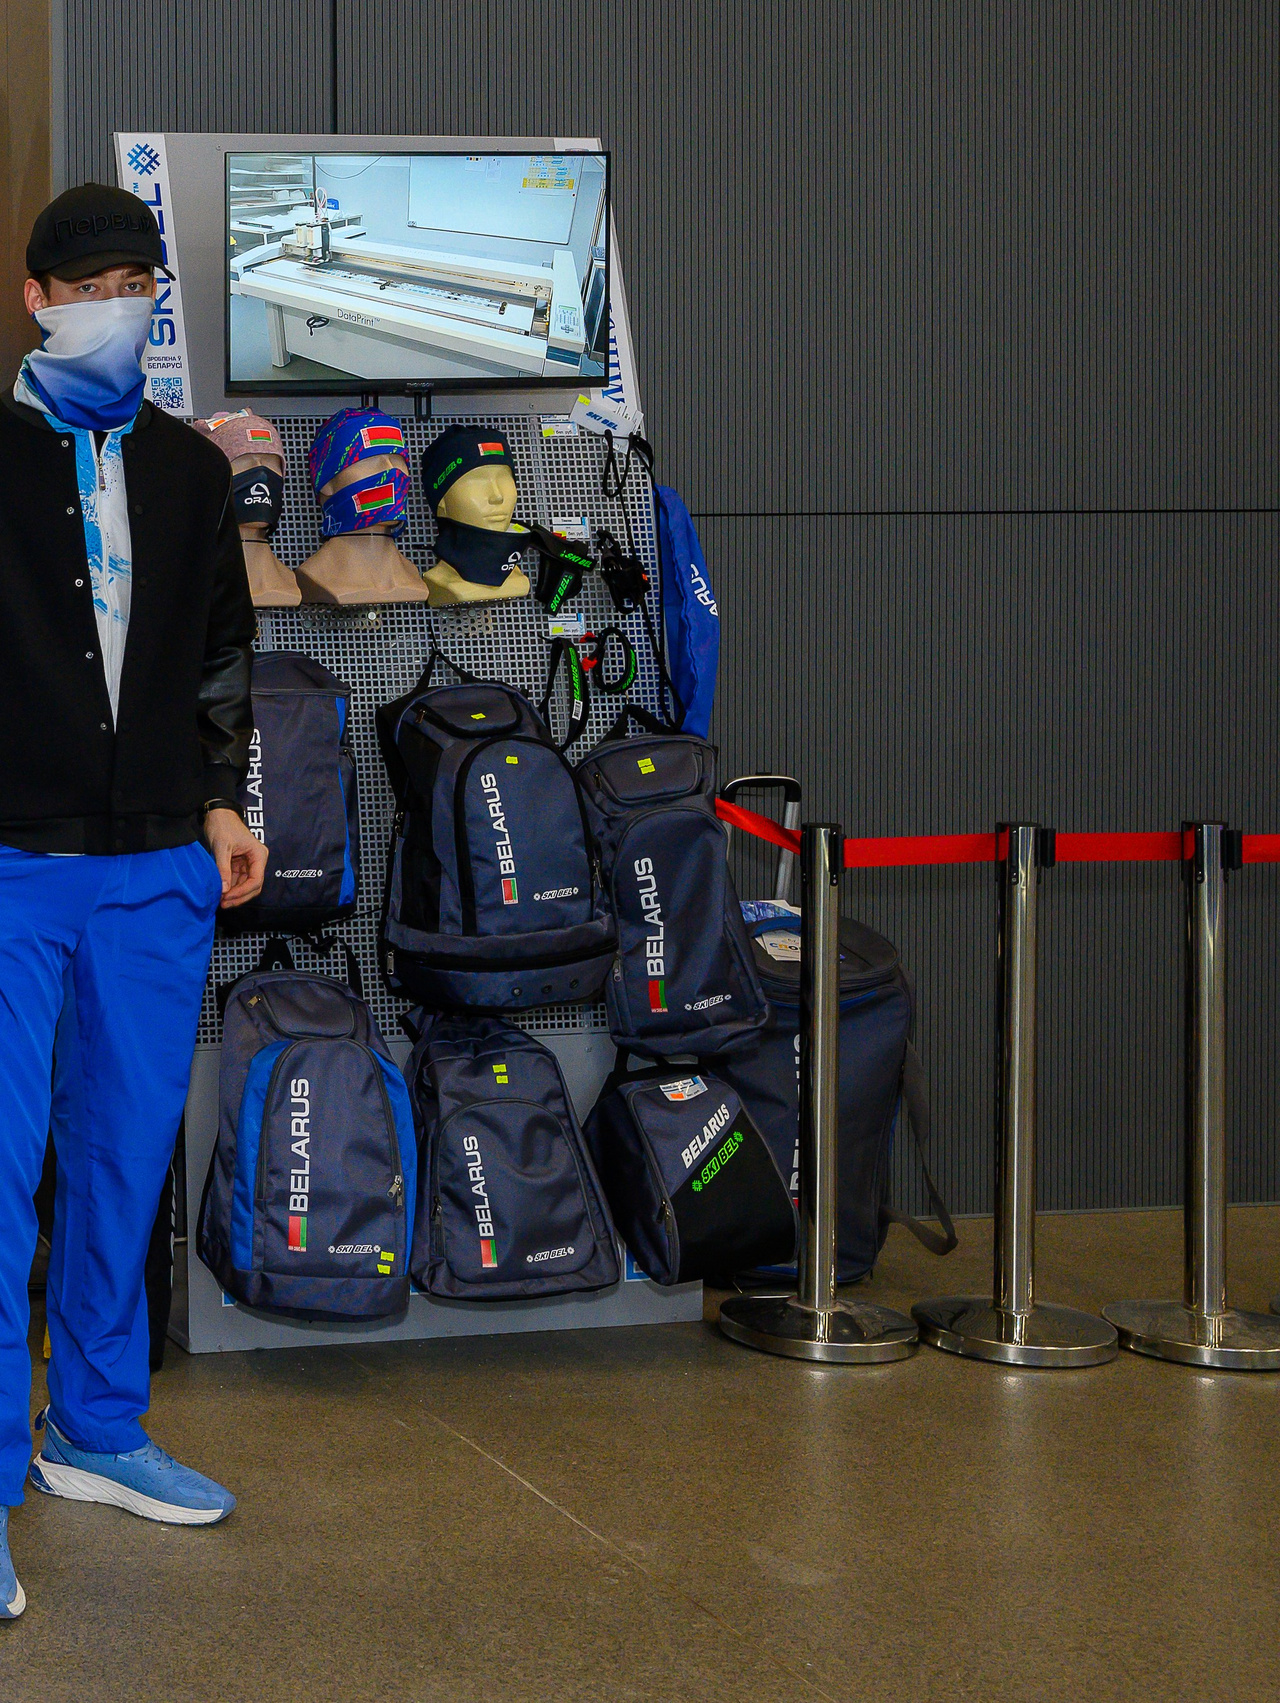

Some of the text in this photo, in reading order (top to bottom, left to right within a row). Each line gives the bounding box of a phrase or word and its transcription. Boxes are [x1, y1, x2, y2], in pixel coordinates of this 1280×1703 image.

[54, 212, 154, 243] Первый
[144, 183, 176, 346] SKIL
[586, 411, 618, 430] SKI BEL
[565, 552, 592, 568] SKI BEL
[550, 578, 569, 612] SKI BEL
[480, 773, 515, 875] BELARUS
[282, 869, 317, 878] SKI BEL
[541, 887, 573, 900] SKI BEL
[633, 857, 665, 976] BELARUS
[693, 995, 724, 1011] SKI BEL
[289, 1078, 309, 1212] BELARUS
[681, 1103, 730, 1169] BELARUS
[701, 1138, 739, 1184] SKI BEL
[463, 1135, 495, 1237] BELARUS
[336, 1244, 373, 1254] SKI BEL
[534, 1247, 568, 1262] SKI BEL
